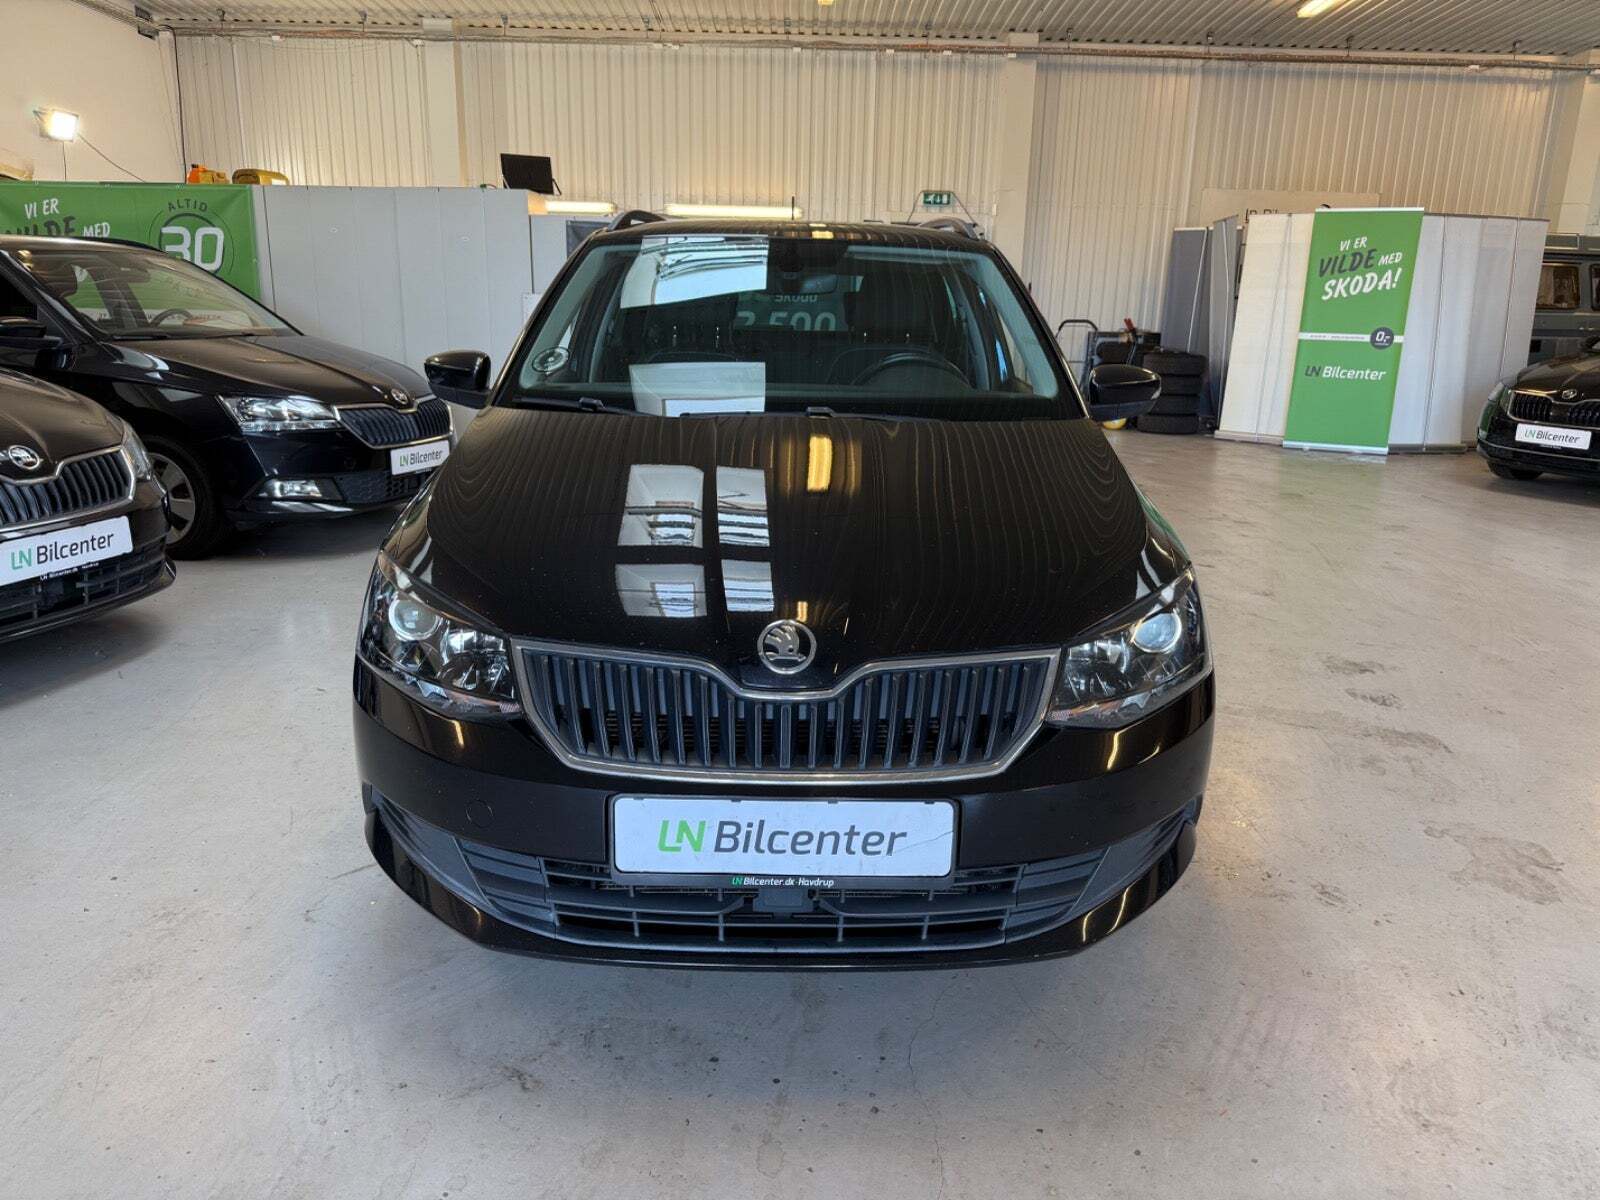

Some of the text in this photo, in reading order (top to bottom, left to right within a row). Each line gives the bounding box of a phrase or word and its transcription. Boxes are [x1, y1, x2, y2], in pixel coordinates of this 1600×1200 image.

[24, 198, 60, 219] VI ER
[168, 198, 208, 212] ALTID
[83, 222, 110, 237] MED
[160, 226, 224, 271] 30
[1340, 236, 1367, 251] VI ER
[1319, 248, 1402, 277] VILDE MED
[1321, 267, 1402, 300] SKODA!
[1322, 366, 1387, 380] Bilcenter
[1536, 430, 1580, 443] Bilcenter
[409, 450, 442, 464] Bilcenter
[11, 533, 115, 570] LN Bilcenter
[658, 820, 907, 857] LN Bilcenter
